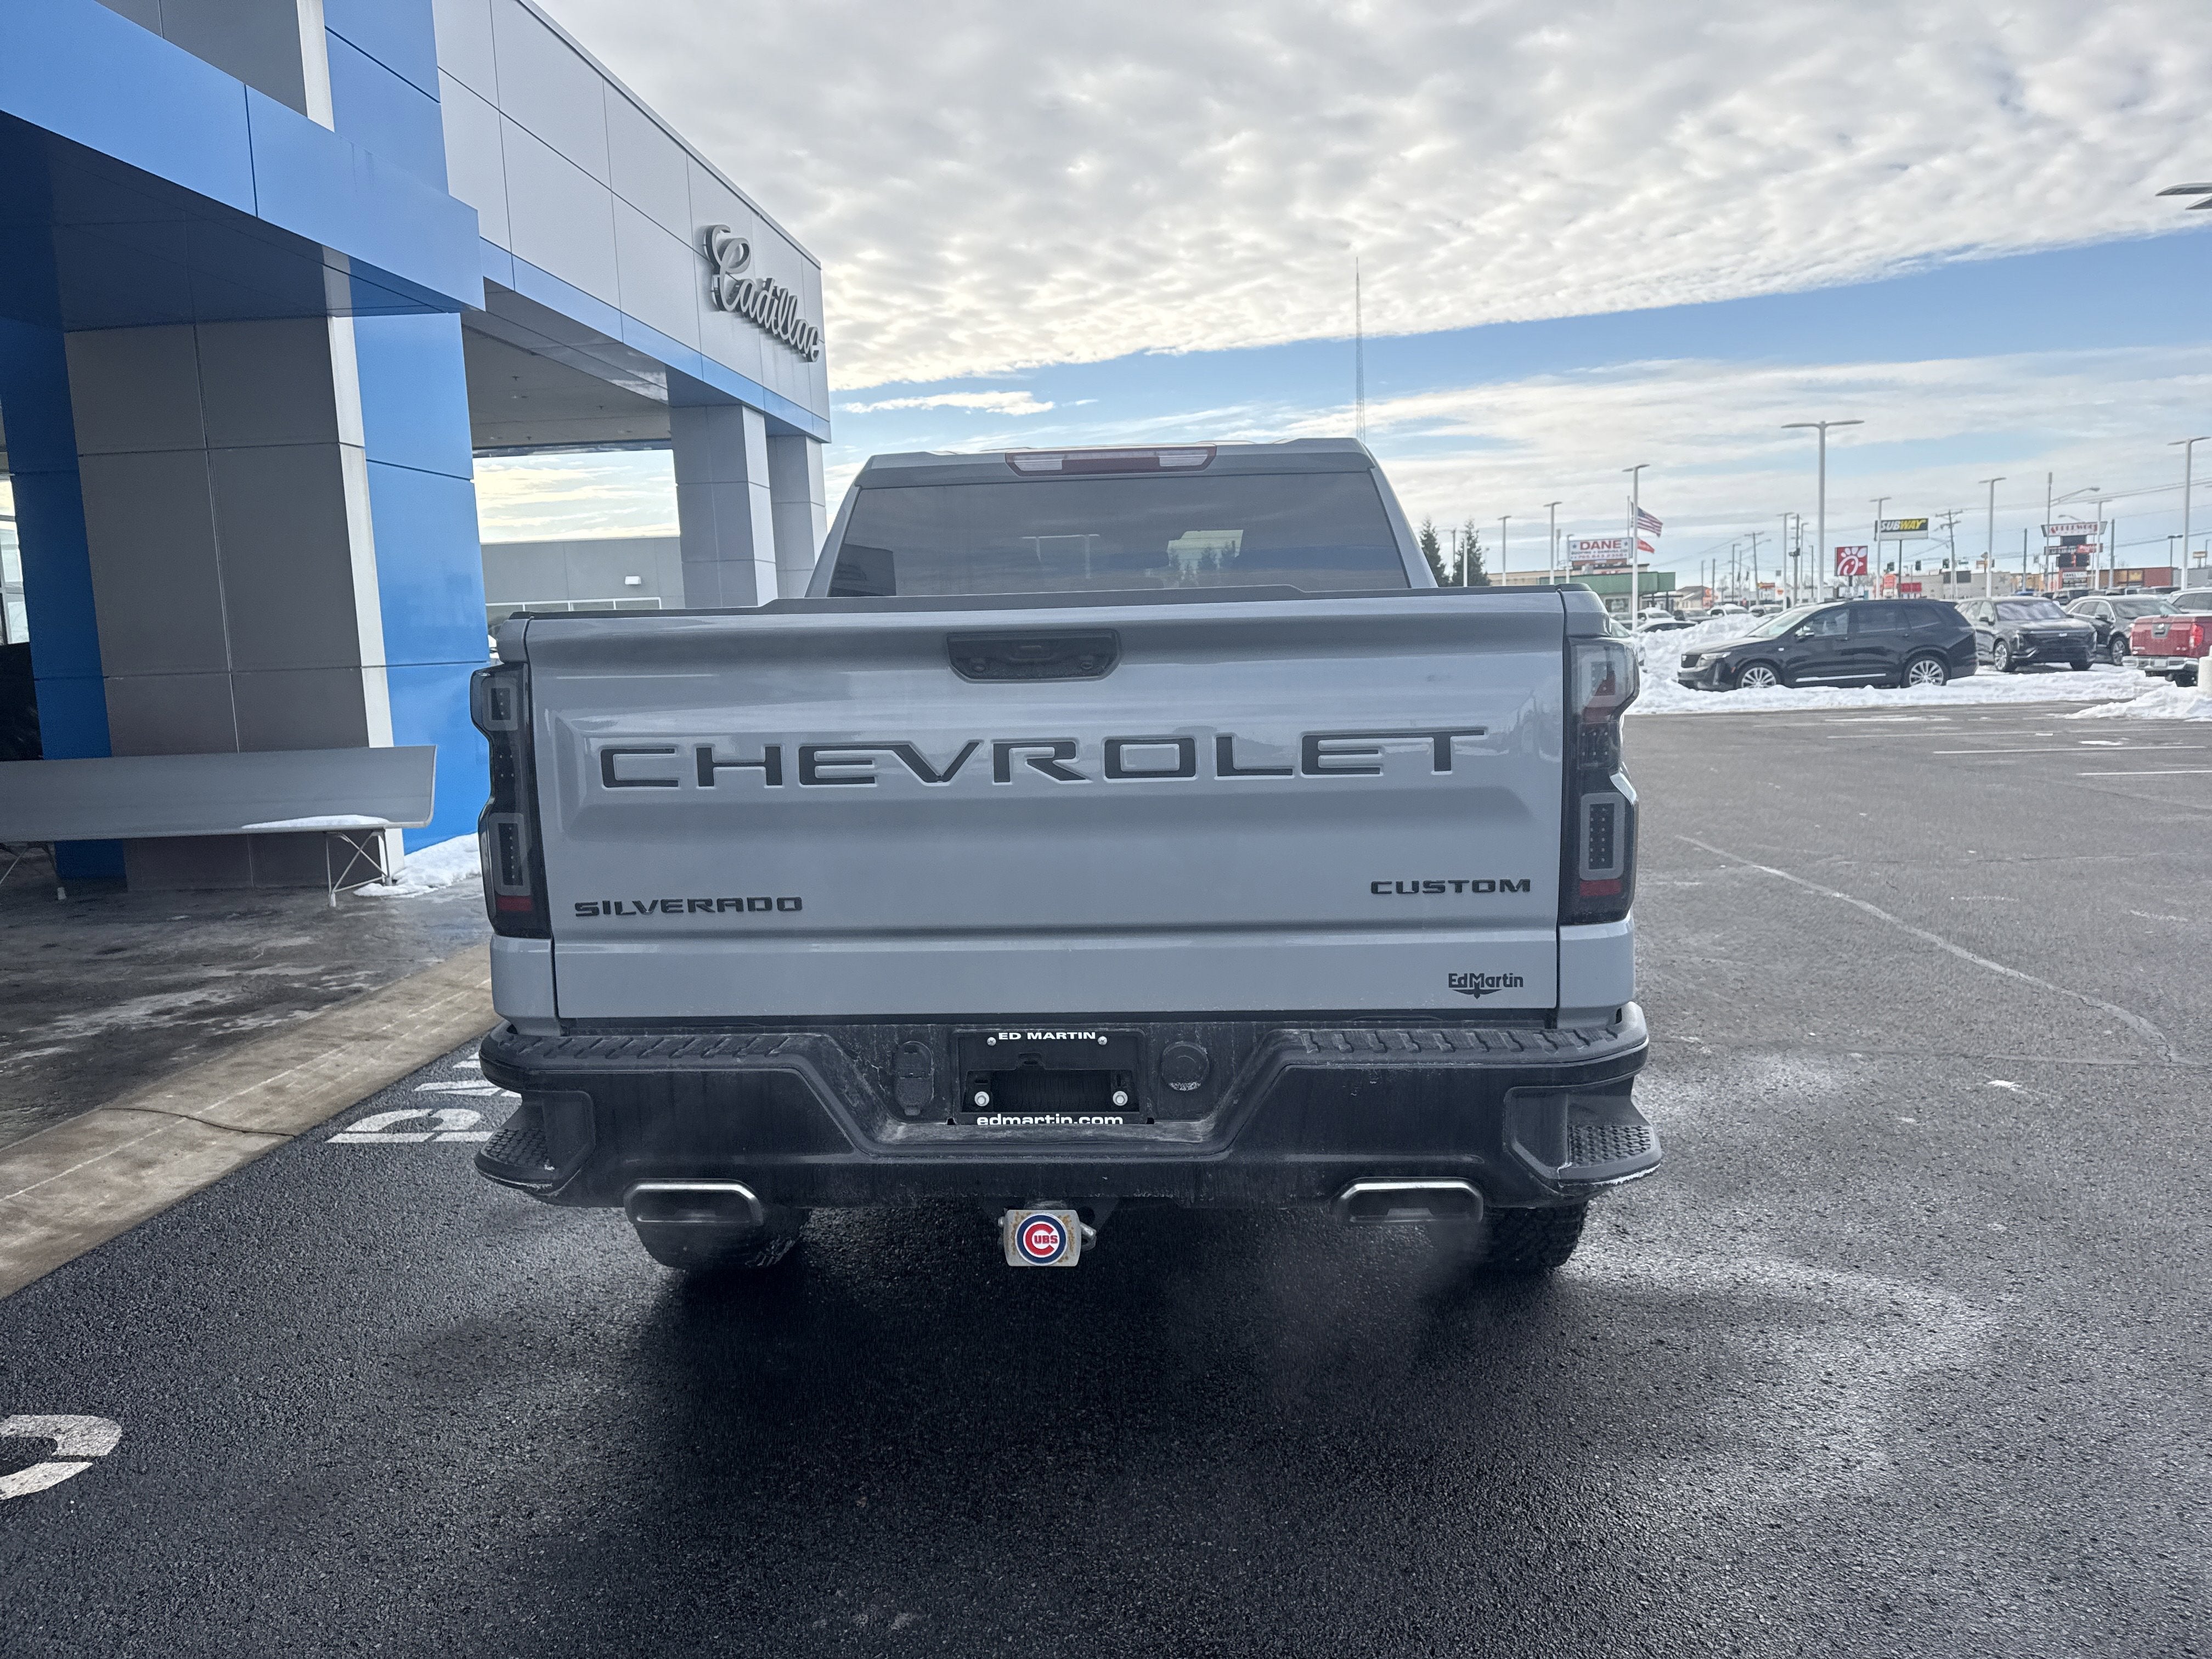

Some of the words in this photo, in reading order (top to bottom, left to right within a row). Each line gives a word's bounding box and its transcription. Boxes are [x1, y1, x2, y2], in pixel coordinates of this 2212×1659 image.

[705, 224, 820, 362] Cadillac
[1881, 519, 1926, 531] SUBWAY
[1580, 540, 1622, 550] DANE
[600, 729, 1485, 788] CHEVROLET
[1371, 879, 1531, 894] CUSTOM
[574, 896, 803, 917] SILVERADO
[998, 1032, 1022, 1040] ED
[1027, 1031, 1096, 1040] MARTIN
[977, 1113, 1124, 1125] edmartin.com
